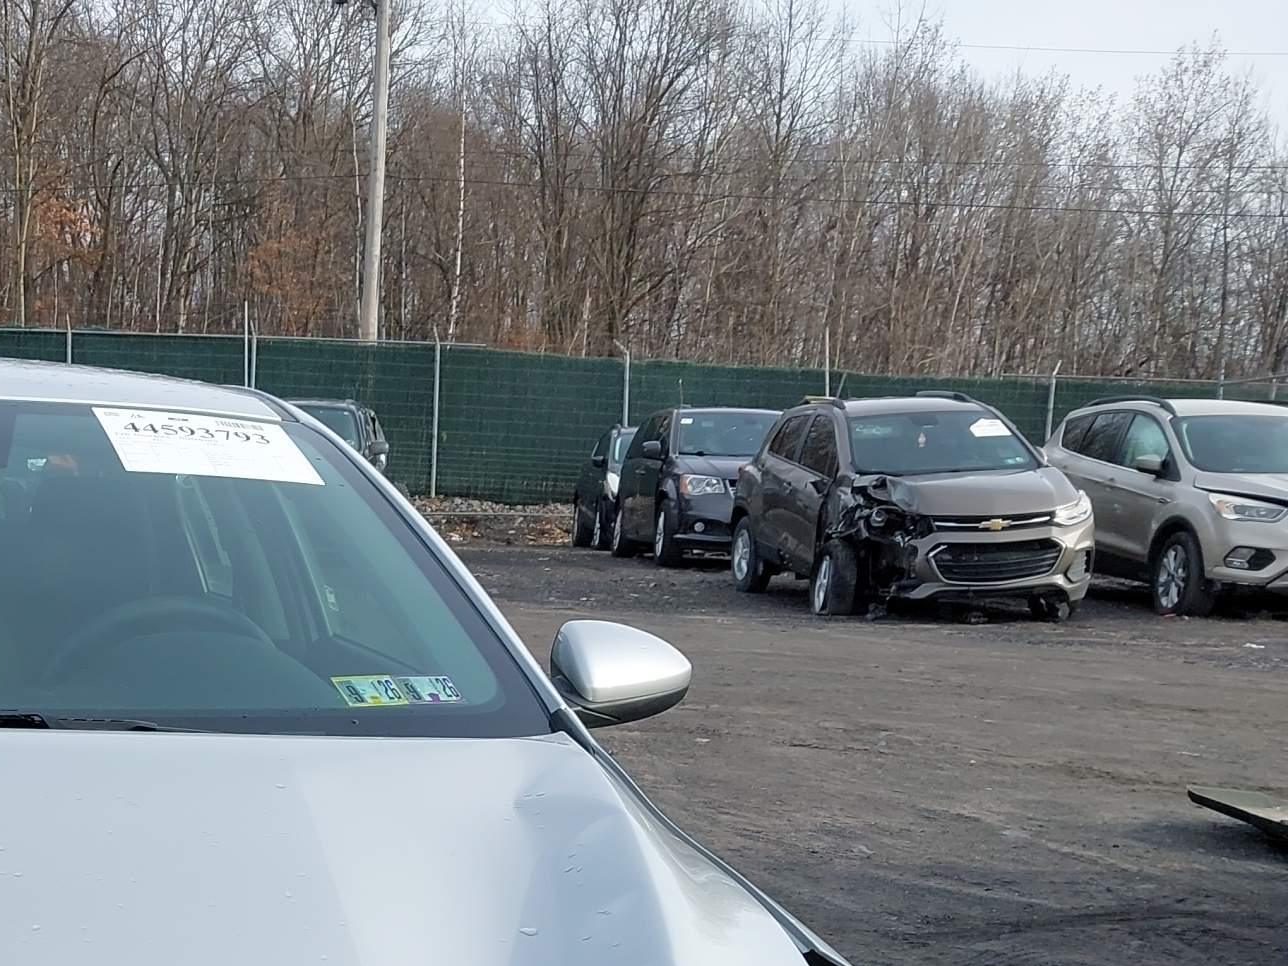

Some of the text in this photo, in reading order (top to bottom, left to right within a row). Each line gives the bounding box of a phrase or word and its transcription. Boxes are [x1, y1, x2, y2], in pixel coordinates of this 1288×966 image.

[123, 421, 271, 445] 44593793
[376, 679, 402, 700] 26
[435, 677, 459, 698] 26
